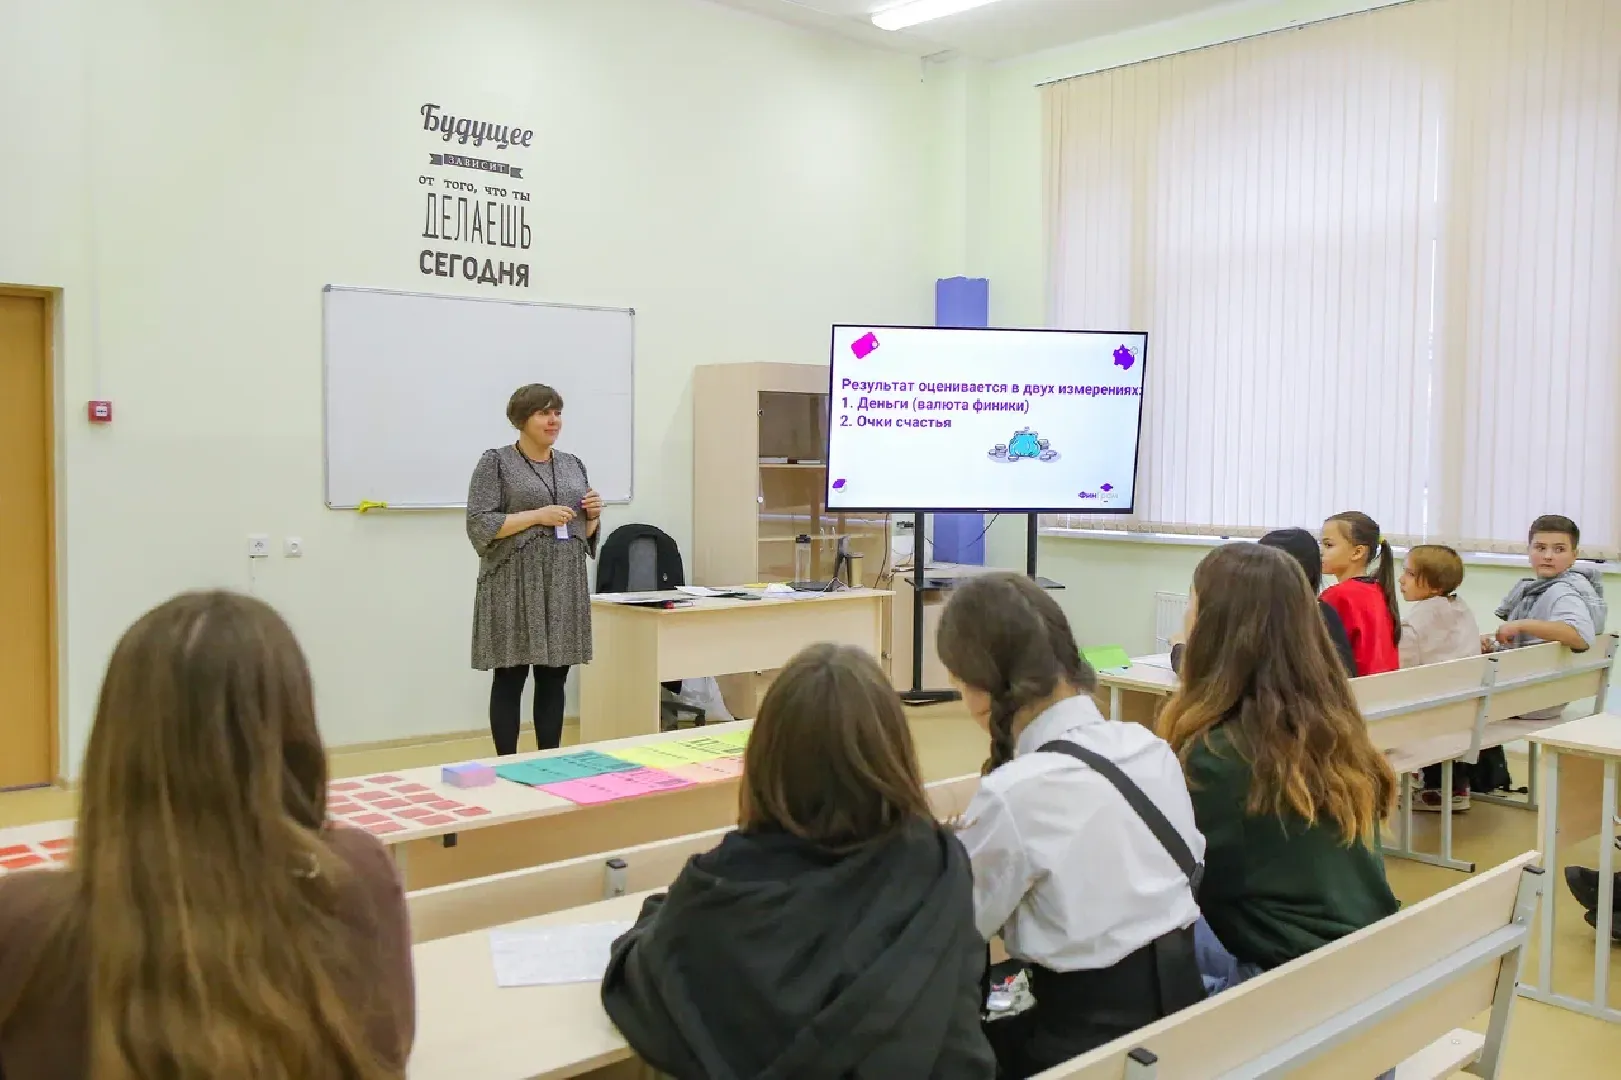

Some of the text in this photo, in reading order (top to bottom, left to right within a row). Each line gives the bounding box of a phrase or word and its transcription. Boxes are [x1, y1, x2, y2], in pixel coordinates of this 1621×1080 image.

[421, 103, 534, 150] Будущее
[448, 155, 506, 173] ЗАВИСИТ
[418, 175, 531, 202] от того, что ты
[422, 192, 532, 250] ДЕЛАЕШЬ
[419, 249, 530, 288] СЕГОДНЯ
[842, 378, 915, 393] Результат
[918, 382, 1007, 394] оценивается
[1012, 384, 1020, 393] в
[1023, 385, 1054, 396] двух
[841, 397, 1030, 414] 1. Деньги (валюта финики)
[840, 415, 952, 428] 2. Очки счастья
